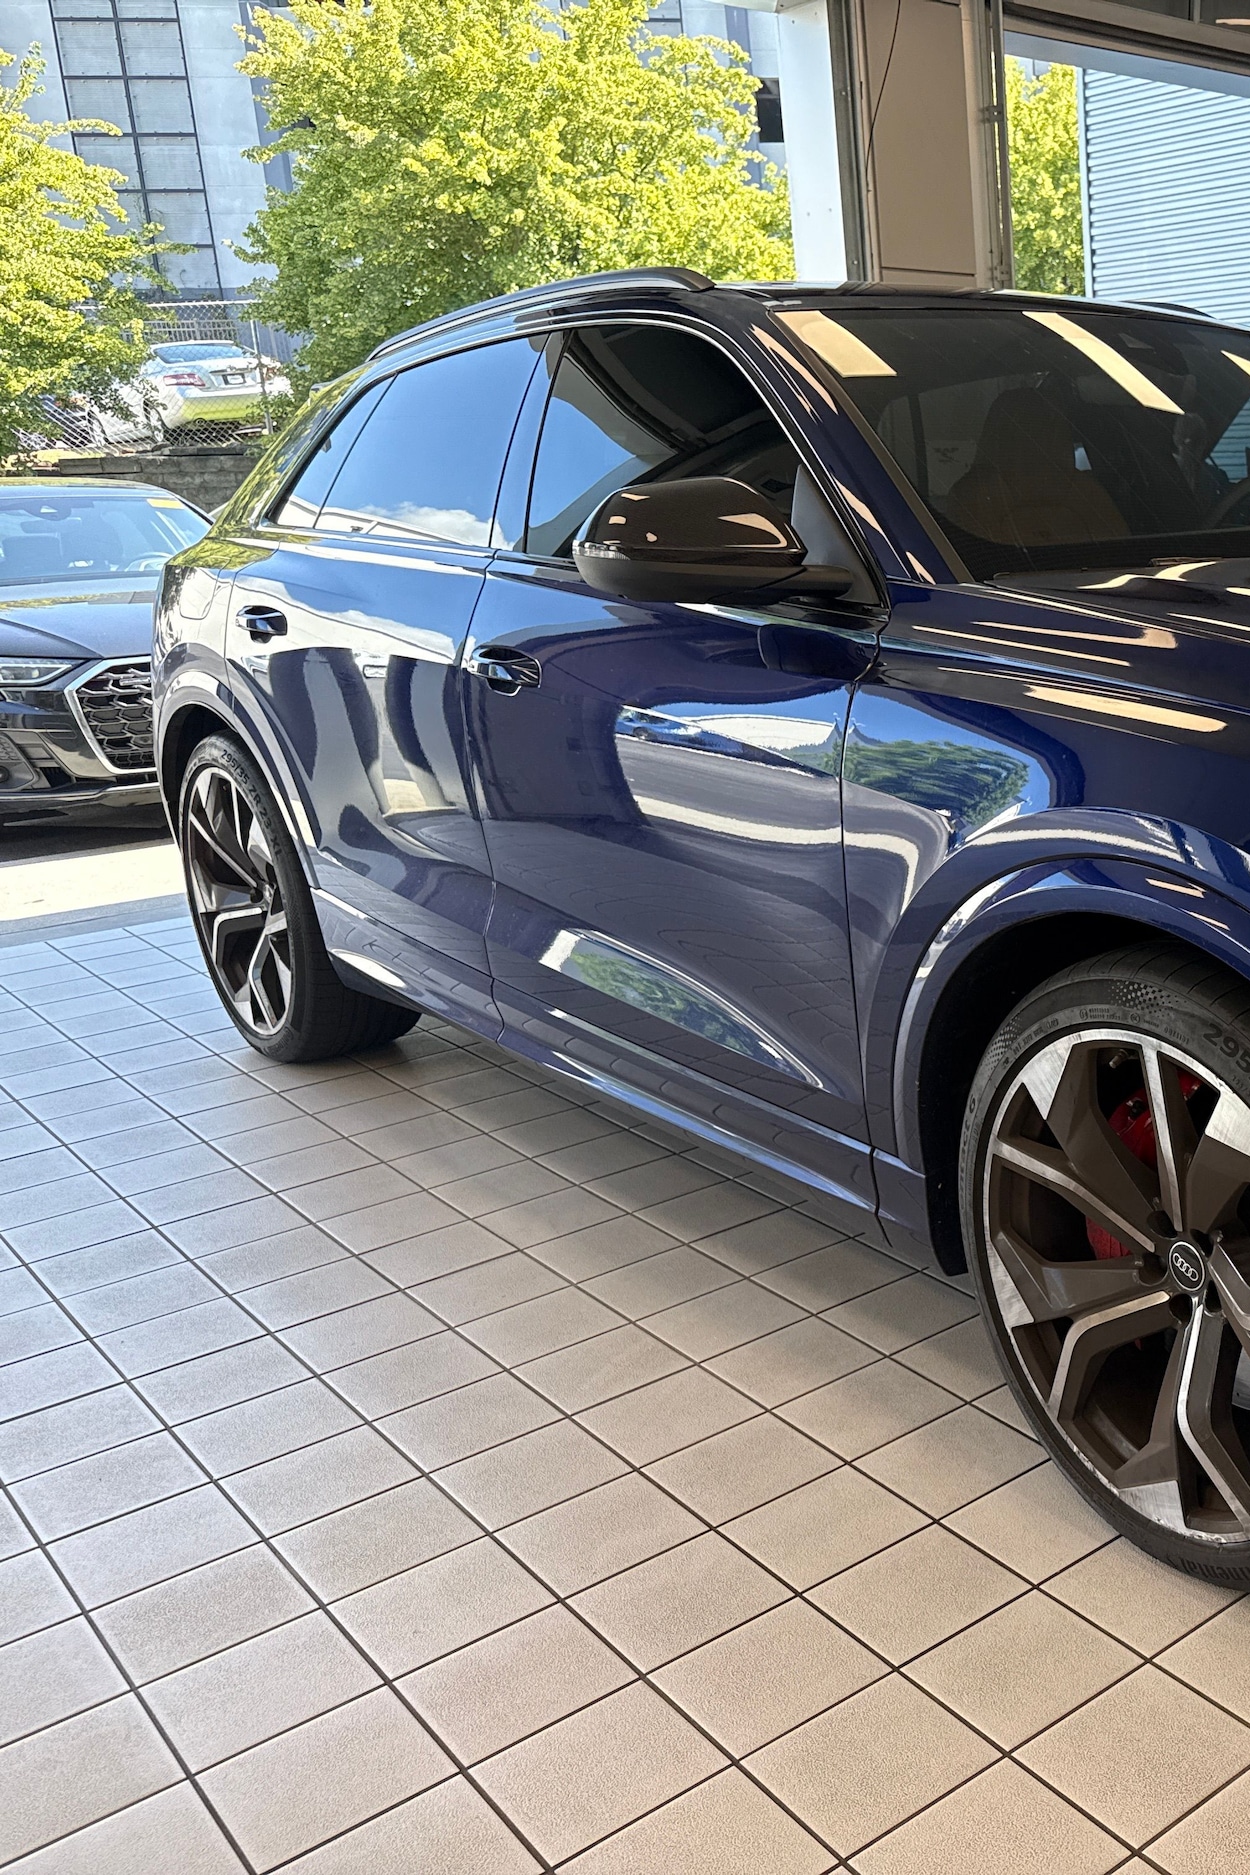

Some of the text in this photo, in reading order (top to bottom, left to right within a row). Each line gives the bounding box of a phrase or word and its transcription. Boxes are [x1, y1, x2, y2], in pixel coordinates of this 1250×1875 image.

[221, 750, 282, 856] 295/35 ZR 23 XL
